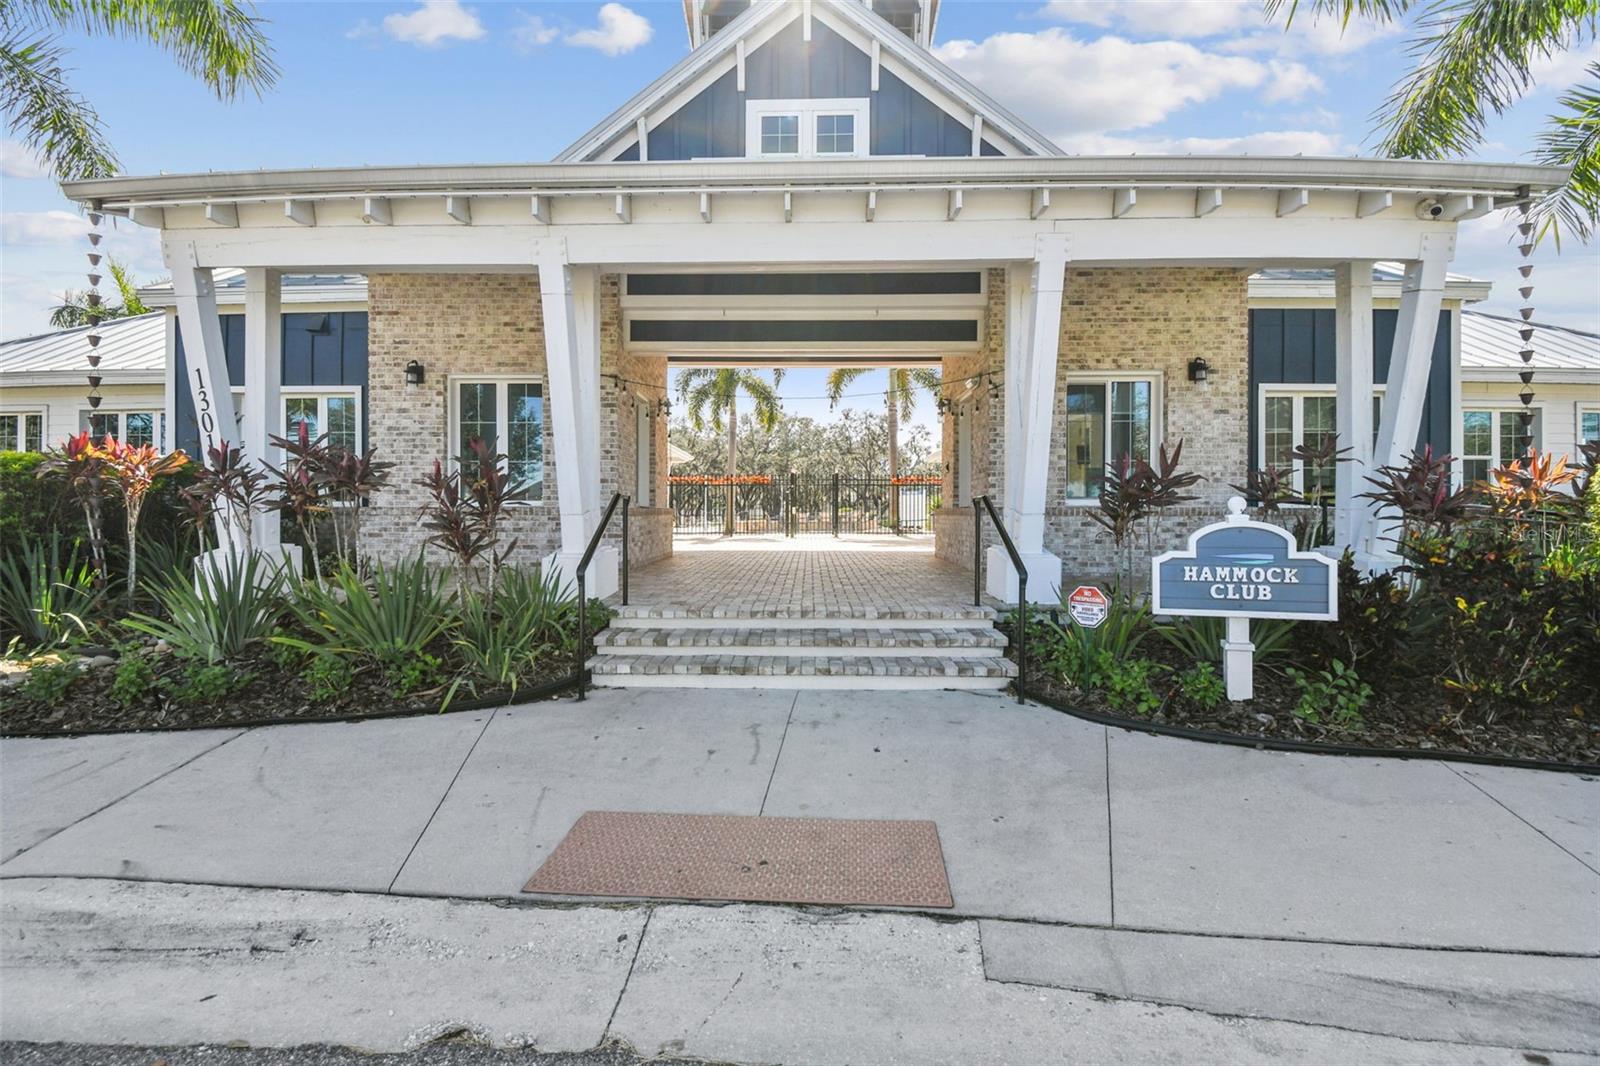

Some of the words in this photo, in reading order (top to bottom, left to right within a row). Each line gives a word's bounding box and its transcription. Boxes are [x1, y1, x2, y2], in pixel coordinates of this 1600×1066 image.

[195, 367, 214, 449] 1301
[1183, 566, 1299, 584] HAMMOCK
[1209, 584, 1272, 600] CLUB
